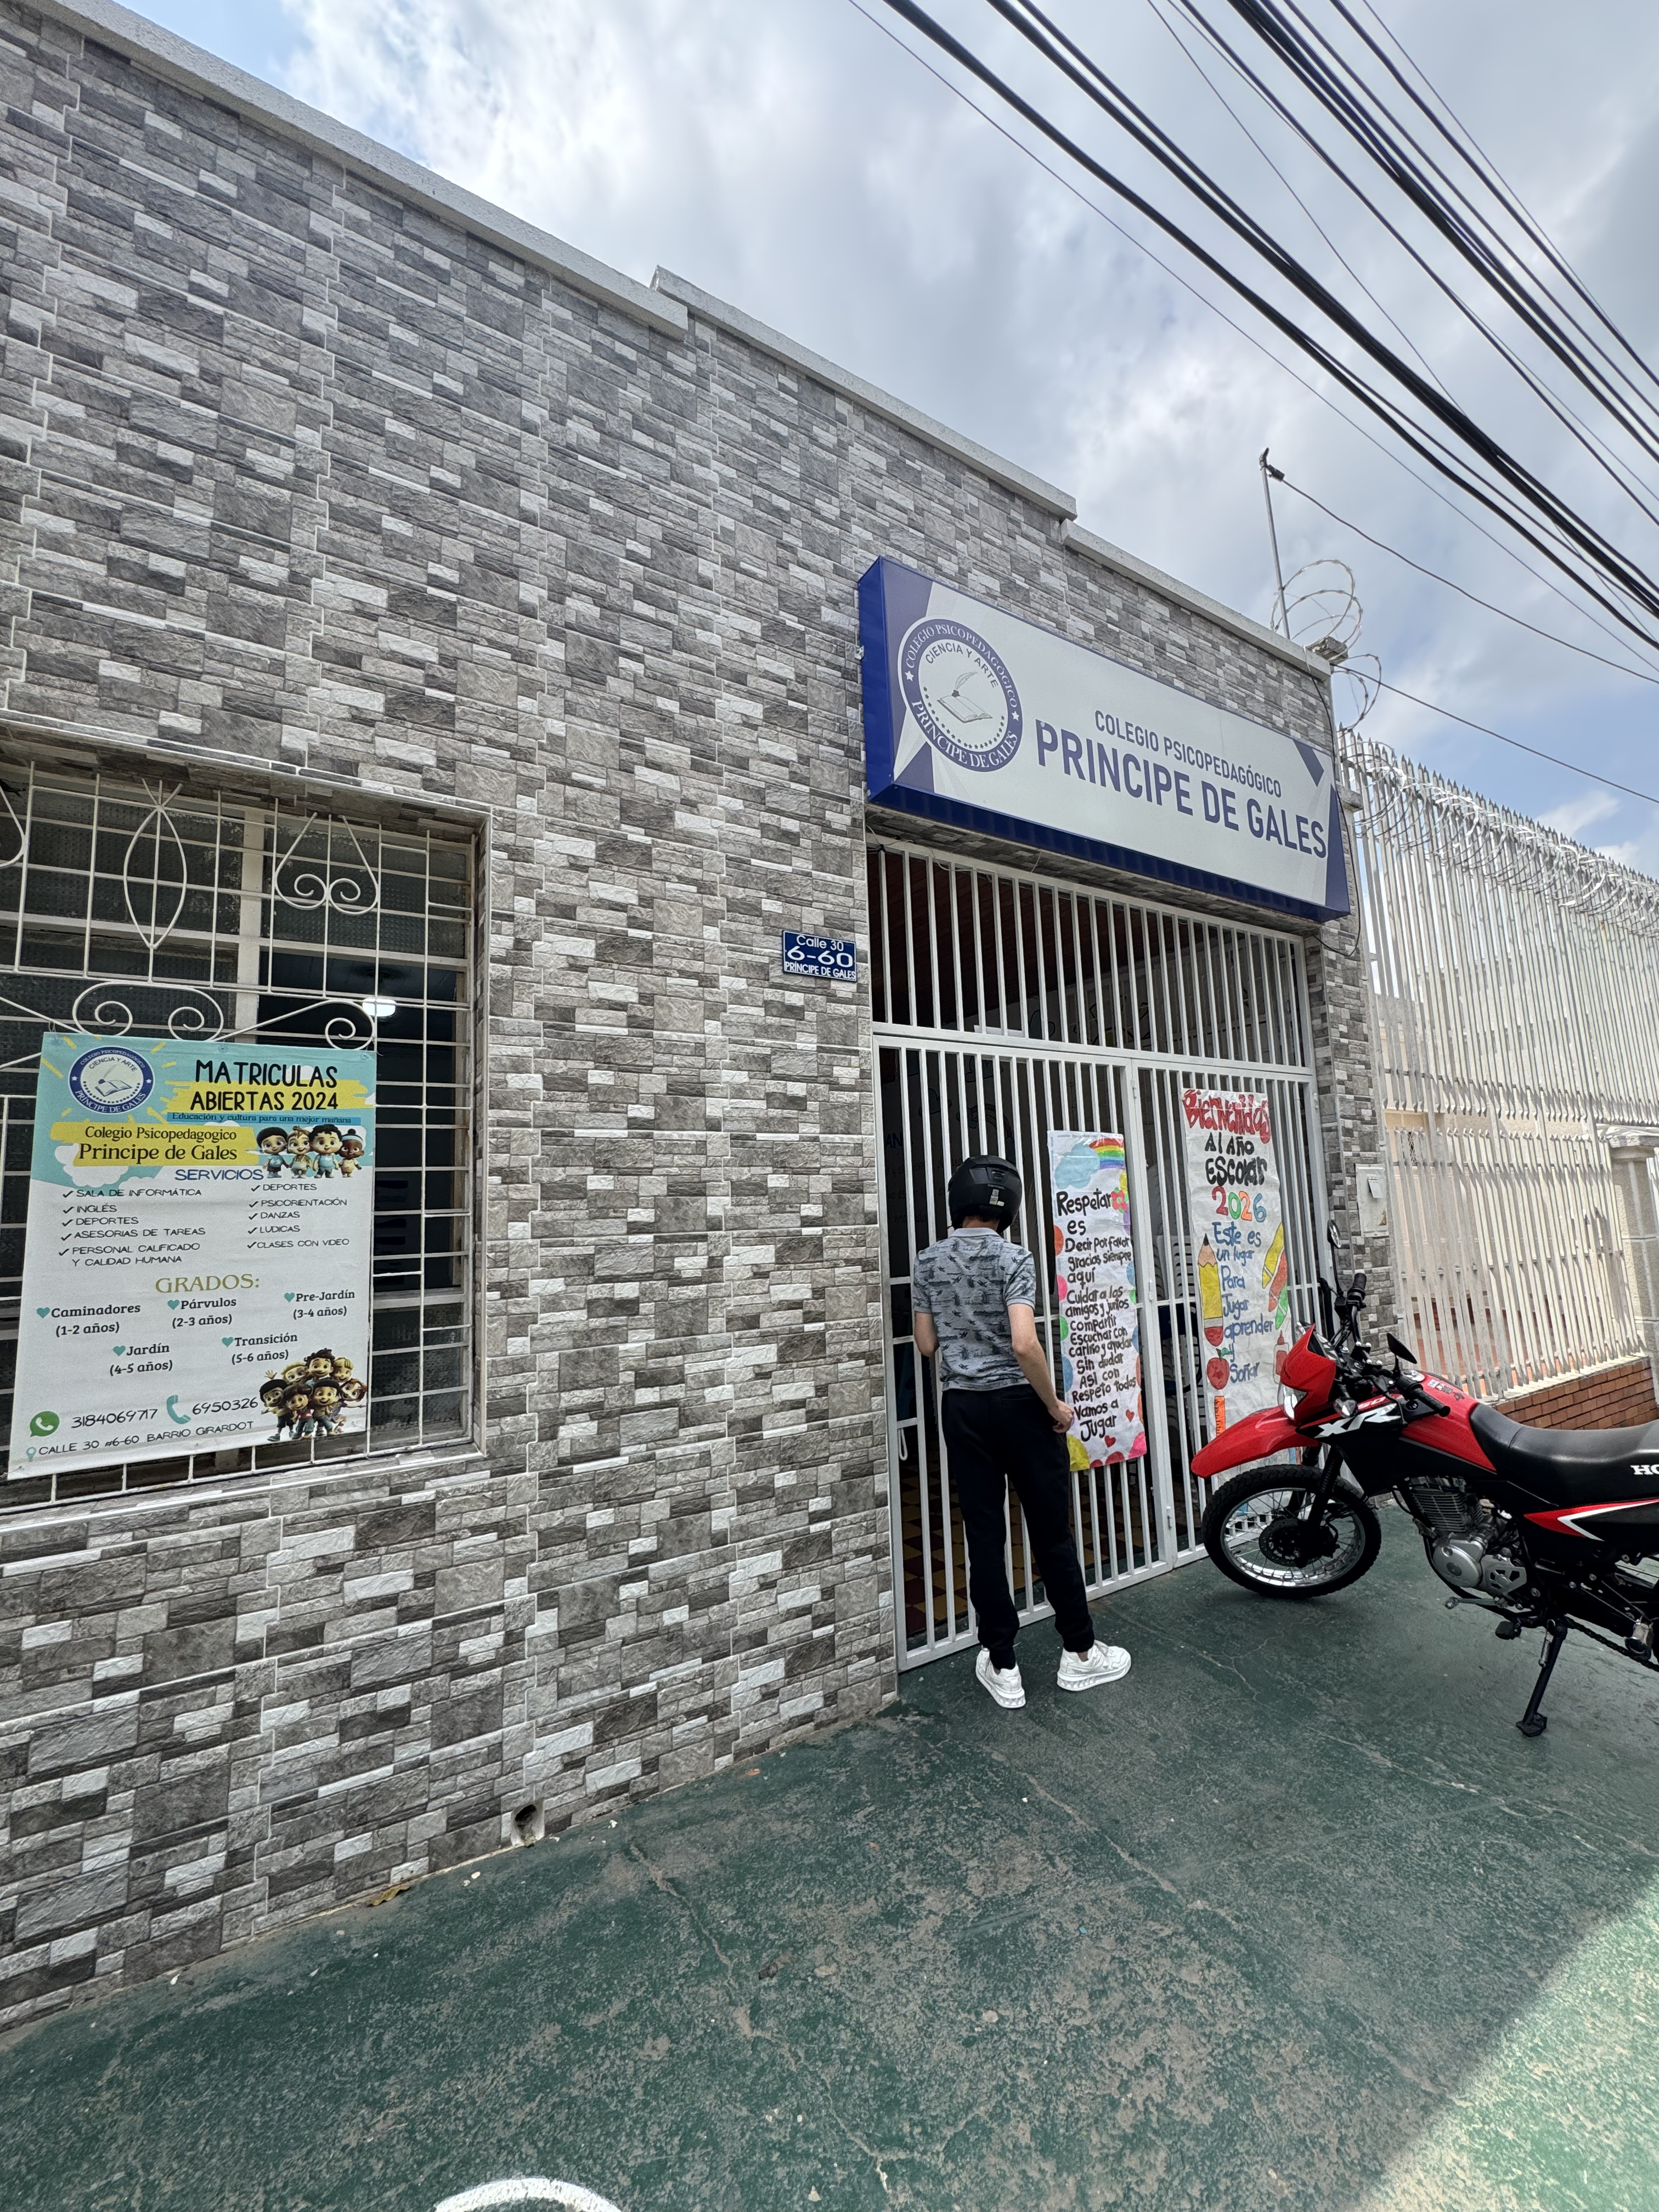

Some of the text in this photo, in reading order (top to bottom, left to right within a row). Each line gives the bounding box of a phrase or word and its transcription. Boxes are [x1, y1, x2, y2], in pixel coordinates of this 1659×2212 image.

[906, 626, 935, 669] COLEGIO
[925, 642, 999, 689] CIENCIA Y ARTE
[969, 753, 989, 768] DE
[988, 730, 1018, 766] GALES
[1094, 710, 1282, 798] COLEGIO PSICOPEDAGÓGICO
[1036, 719, 1327, 859] PRINCIPE DE GALES
[796, 935, 844, 951] Calle 30
[787, 945, 853, 968] 6-60
[785, 961, 856, 980] PRÍNCIPE DE GALES
[80, 1051, 100, 1065] COLEGIO
[89, 1057, 115, 1069] CIENCIA
[121, 1059, 137, 1072] ARTE
[195, 1059, 338, 1088] MATRICULAS
[122, 1092, 146, 1110] GALES
[190, 1091, 338, 1111] ABIERTAS 2024
[296, 1116, 319, 1124] mejor
[1182, 1089, 1271, 1143] Bienvenidos
[85, 1126, 237, 1142] Colegio Psicopedagogico
[1204, 1132, 1222, 1154] Al
[78, 1143, 237, 1165] Principe de Gales
[174, 1169, 264, 1181] SERVICIOS
[128, 1188, 202, 1197] INFORMÁTICA
[76, 1203, 117, 1213] INGLÉS
[261, 1197, 347, 1207] PSICORIENTACIÓN
[1056, 1188, 1111, 1216] Respetar
[1212, 1186, 1267, 1222] 2026
[76, 1217, 139, 1226] DEPORTES
[259, 1225, 300, 1233] LUDICAS
[1067, 1220, 1086, 1236] es
[74, 1229, 138, 1239] ASESORIAS
[163, 1227, 206, 1235] TAREAS
[1212, 1221, 1261, 1248] Este es
[72, 1243, 200, 1255] PERSONAL CALIFICADO
[257, 1240, 294, 1249] CLASES
[1064, 1238, 1092, 1252] Decir
[85, 1257, 131, 1266] CALIDAD
[135, 1256, 182, 1265] HUMANA
[1216, 1245, 1254, 1266] un lugar
[155, 1274, 259, 1293] GRADOS:
[1068, 1267, 1096, 1290] aquí
[1221, 1265, 1245, 1291] Para
[296, 1289, 355, 1302] Pre-Jardín
[1099, 1290, 1107, 1299] a
[1109, 1285, 1123, 1298] los
[51, 1304, 141, 1318] Caminadores
[180, 1297, 236, 1310] Párvulos
[1099, 1303, 1104, 1317] y
[1221, 1293, 1249, 1321] Jugar
[172, 1314, 233, 1329] (2-3 años)
[293, 1306, 347, 1321] (3-4 años)
[55, 1322, 120, 1338] (1-2 años)
[1070, 1326, 1127, 1345] Escuchar con
[1224, 1312, 1273, 1343] aprender
[234, 1332, 298, 1346] Transición
[126, 1342, 170, 1356] Jardín
[232, 1350, 289, 1365] (5-6 años)
[1101, 1343, 1106, 1358] y
[1229, 1343, 1235, 1363] y
[109, 1359, 173, 1377] (4-5 años)
[1102, 1368, 1119, 1381] con
[1071, 1375, 1136, 1404] Respeto todos
[193, 1397, 258, 1415] 6950326
[1074, 1399, 1119, 1420] Vamos a
[71, 1408, 158, 1429] 3184069717
[1080, 1415, 1117, 1442] Jugar
[38, 1421, 254, 1455] CALLE 30 #6-60 BARRIO GIRARDOT
